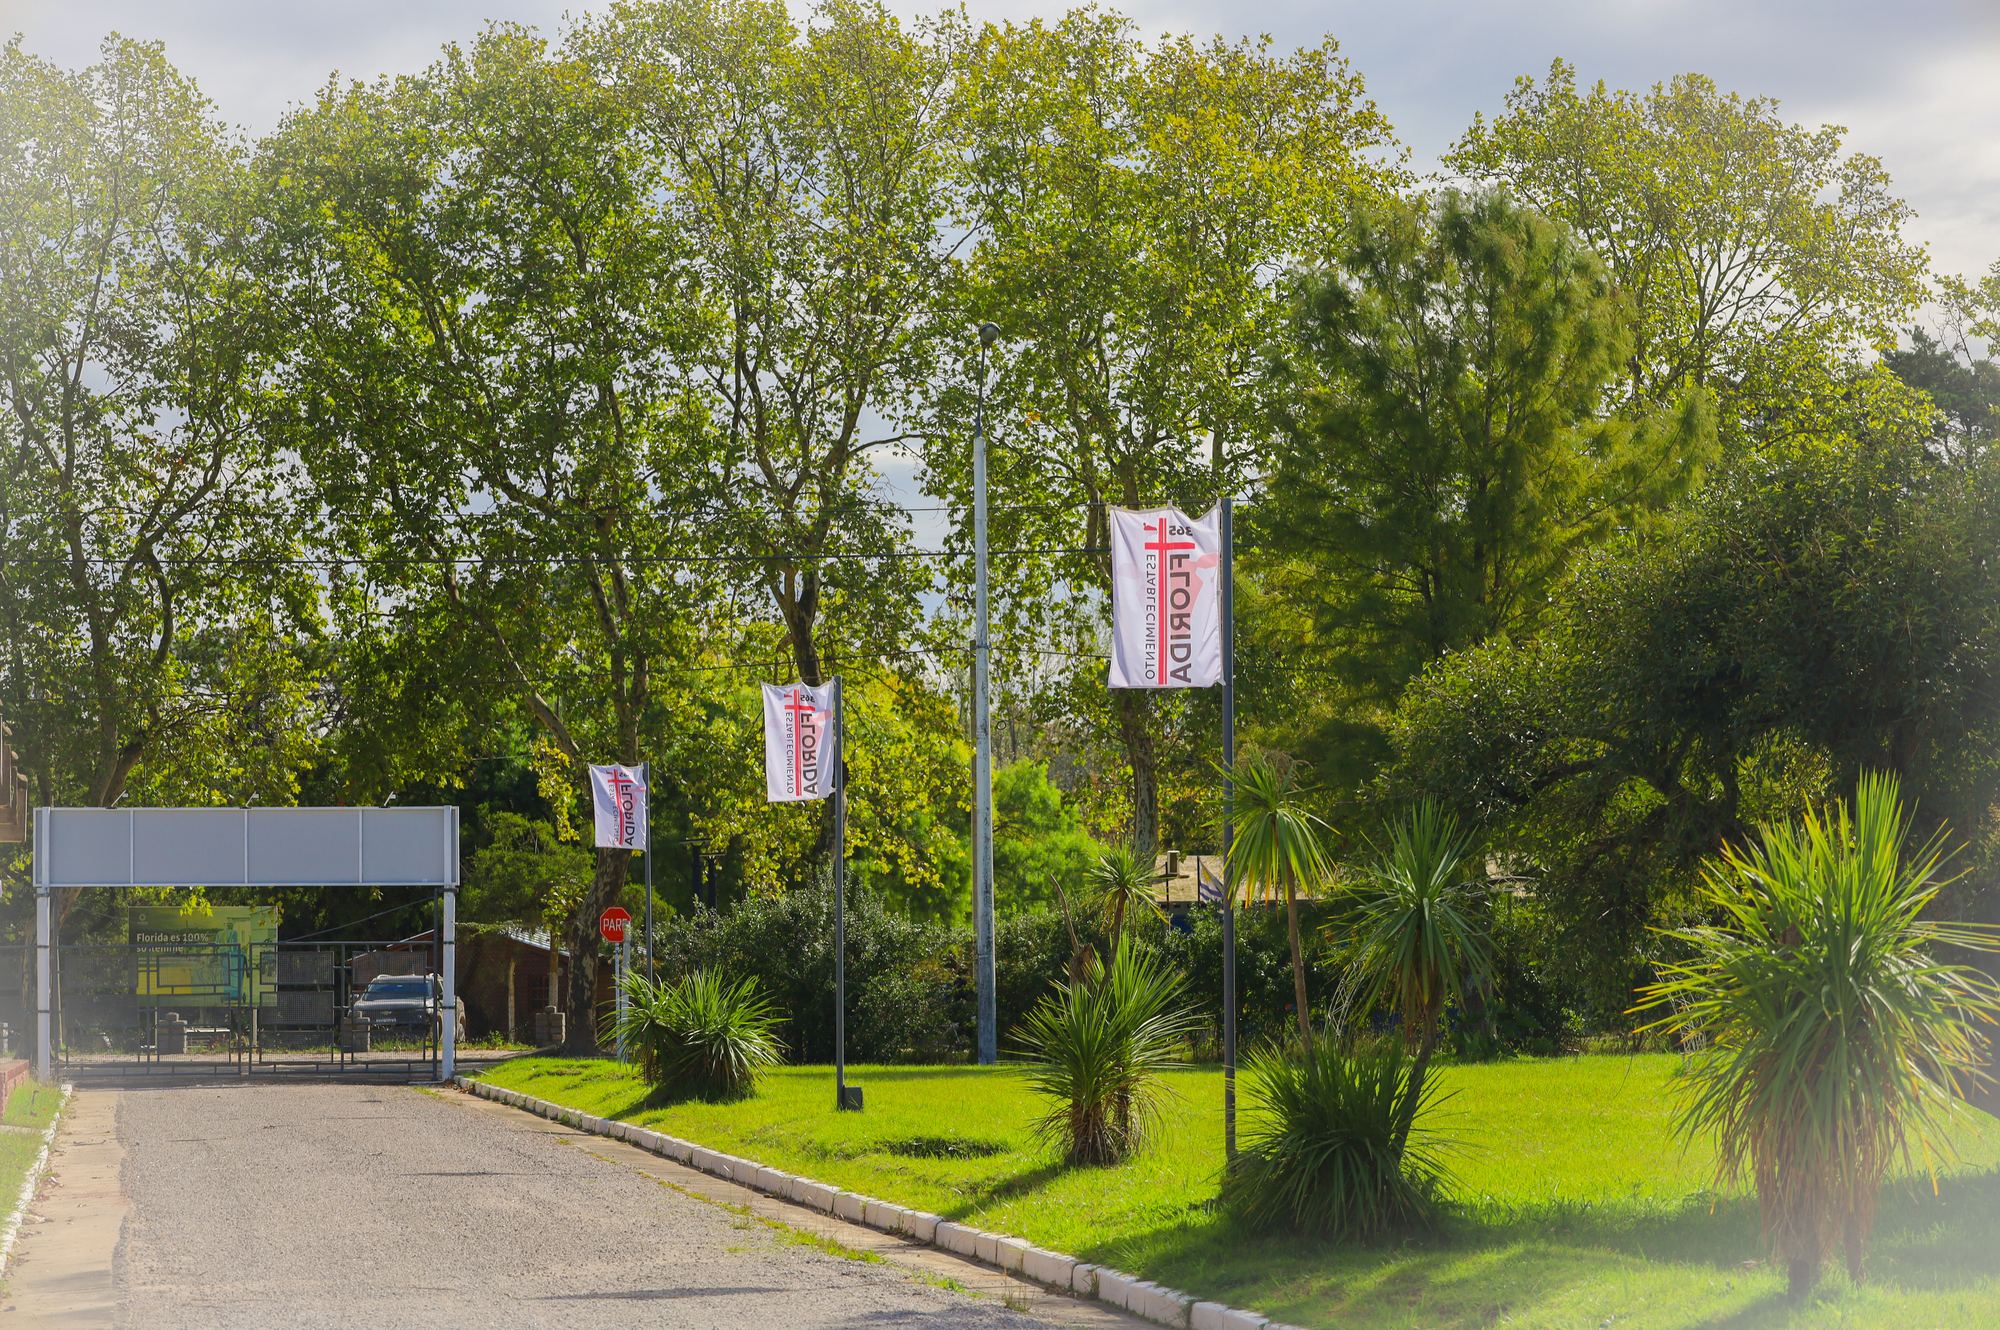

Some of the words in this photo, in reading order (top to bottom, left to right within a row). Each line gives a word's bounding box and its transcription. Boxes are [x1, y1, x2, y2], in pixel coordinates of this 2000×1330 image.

[136, 932, 168, 943] Florida
[170, 934, 181, 942] es
[182, 932, 209, 943] 100%
